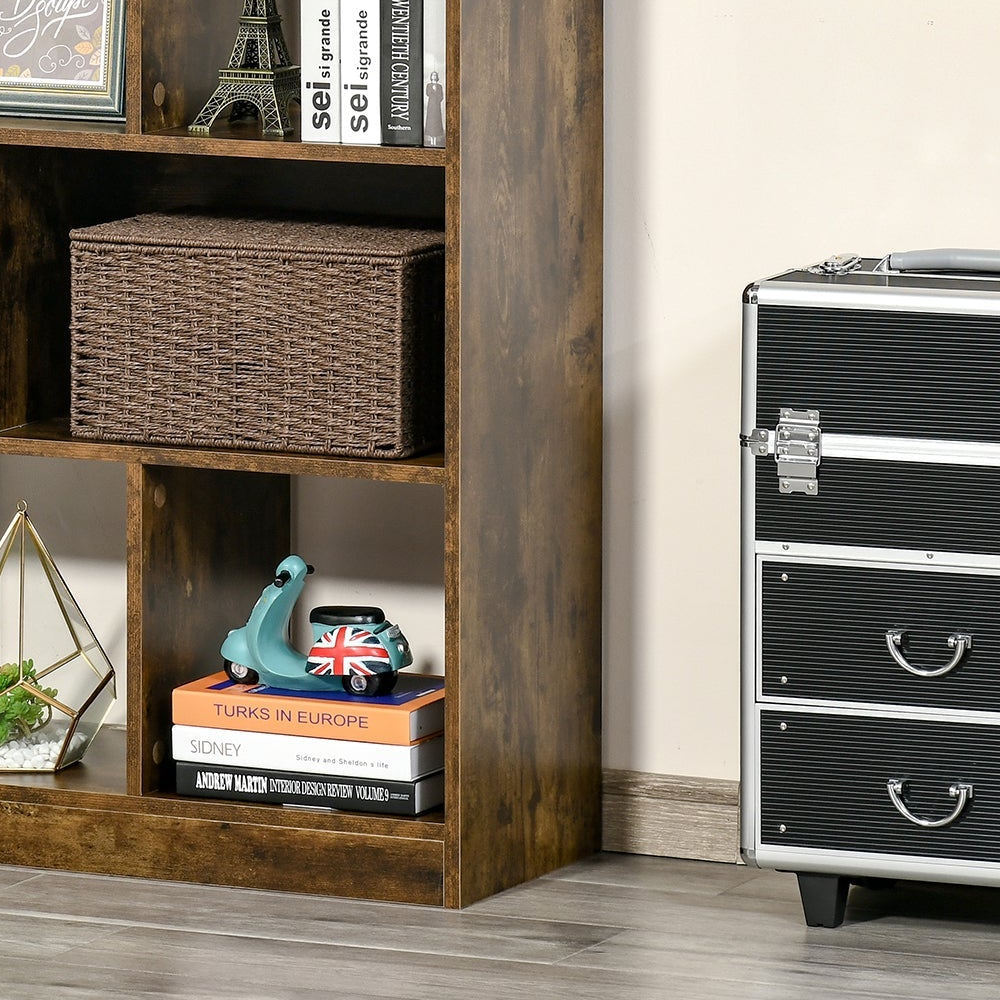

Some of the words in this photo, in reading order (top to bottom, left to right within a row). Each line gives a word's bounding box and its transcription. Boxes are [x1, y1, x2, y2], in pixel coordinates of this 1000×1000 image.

[319, 9, 333, 61] grande
[319, 66, 330, 78] si
[306, 82, 331, 130] sei
[391, 63, 409, 121] CENTURY
[344, 84, 369, 132] sei
[213, 703, 270, 720] TURKS
[276, 709, 292, 722] IN
[297, 711, 369, 729] EUROPE
[190, 739, 241, 757] SIDNEY
[296, 755, 320, 763] Sidney
[339, 758, 367, 767] Sheldon
[196, 771, 232, 791] ANDREW
[234, 774, 268, 794] MARTIN
[269, 778, 301, 794] INTERIOR
[301, 781, 326, 796] DESIGN
[327, 783, 353, 798] REVIEW
[355, 785, 384, 801] VOLUME
[385, 788, 389, 802] 9
